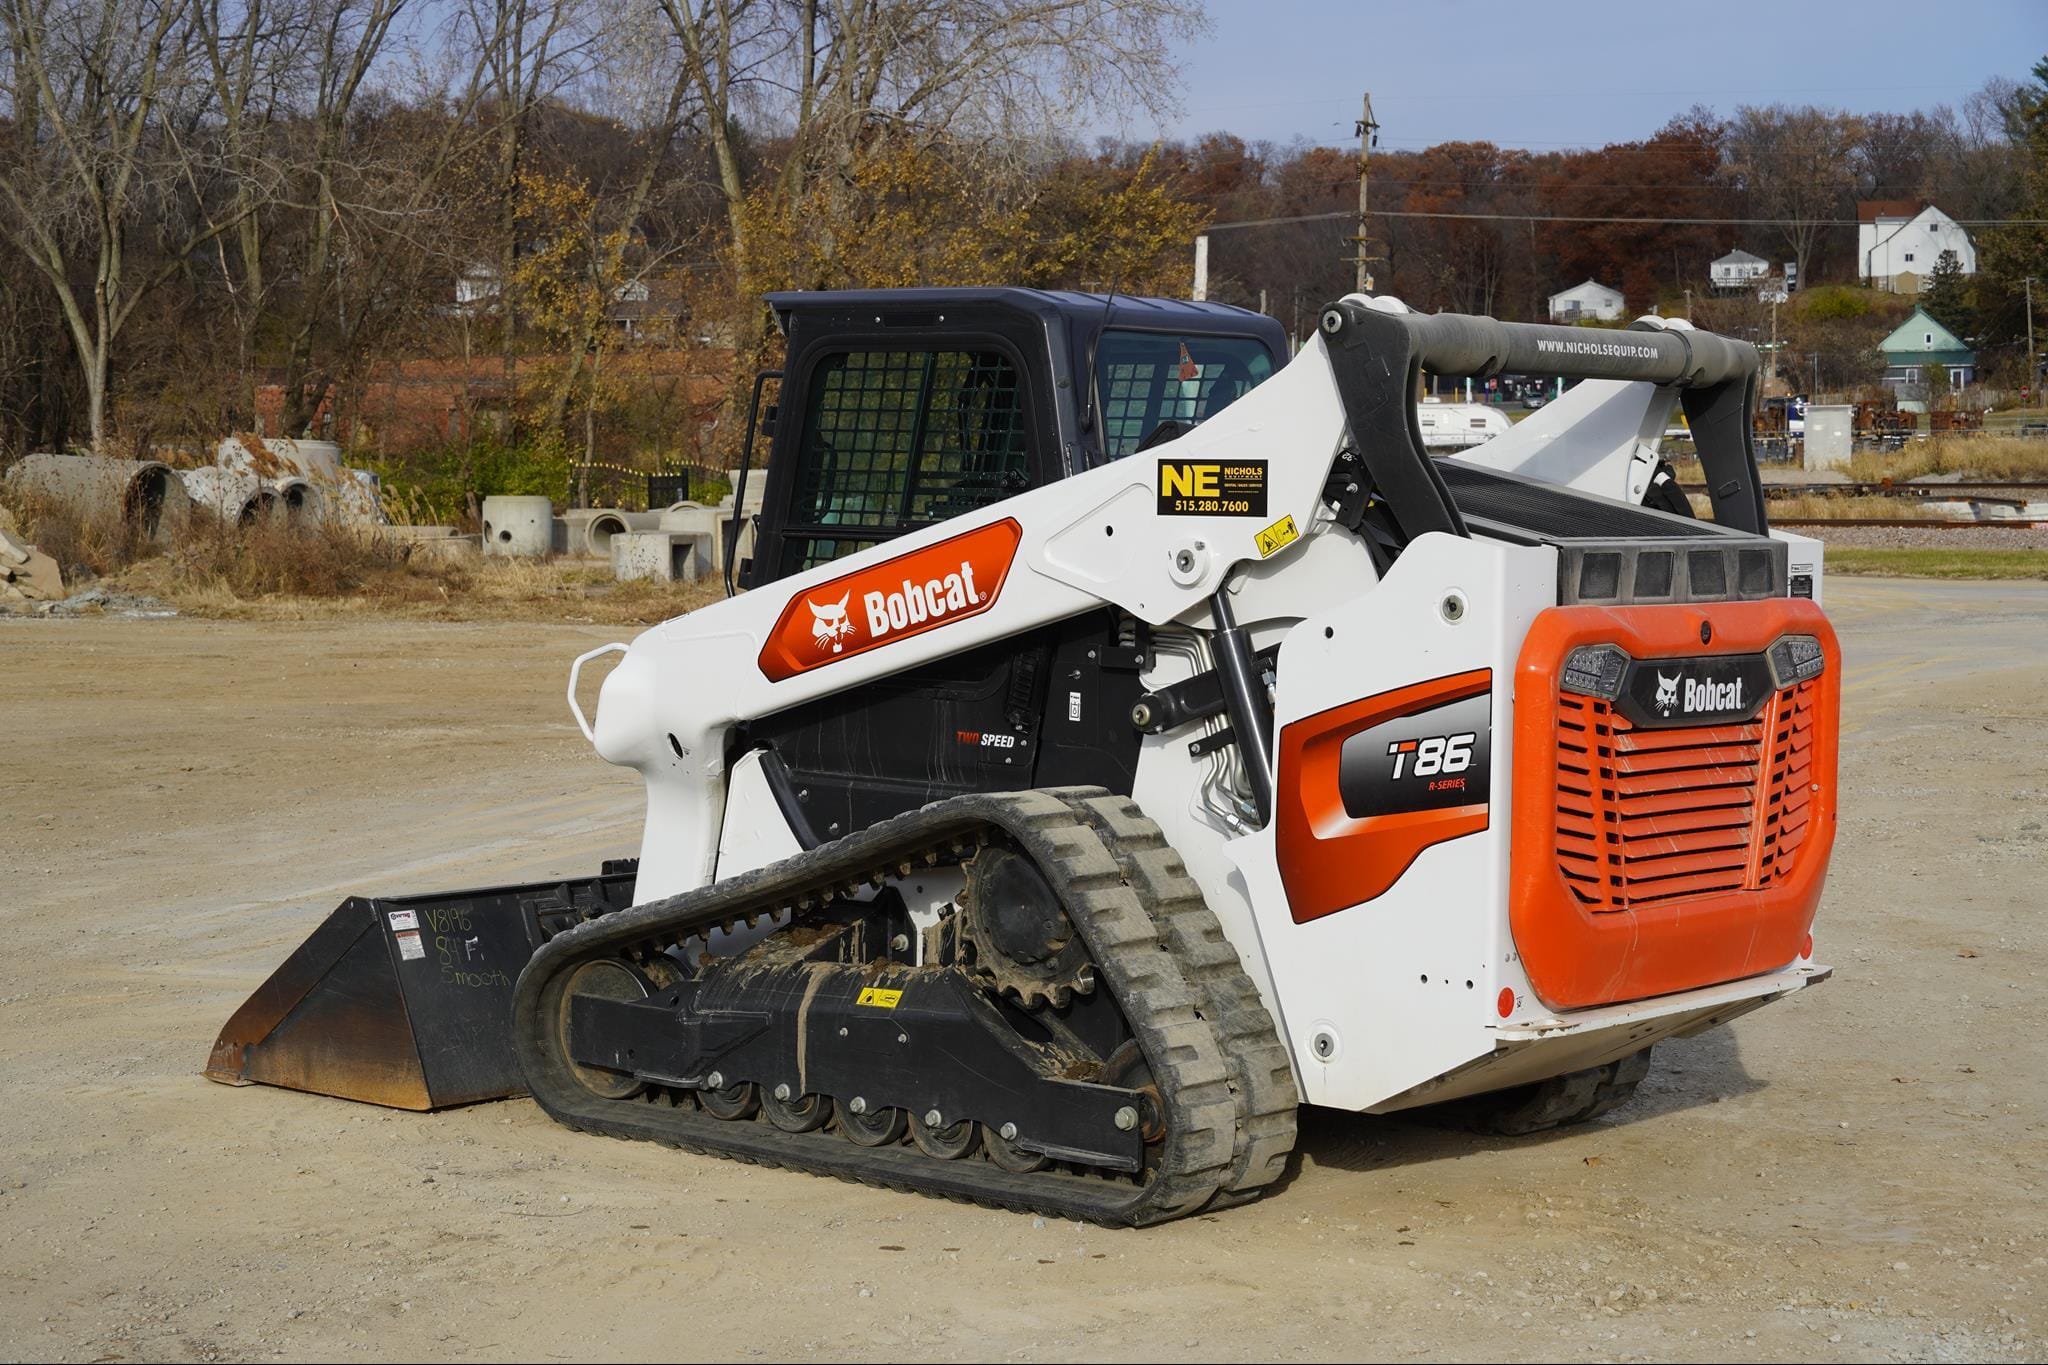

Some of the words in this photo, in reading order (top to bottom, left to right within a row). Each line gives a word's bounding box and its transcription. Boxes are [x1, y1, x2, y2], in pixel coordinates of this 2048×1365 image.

[1537, 339, 1658, 359] WWW.NICHOLSEQUIP.COM
[1162, 465, 1220, 496] NE
[1224, 467, 1263, 475] NICHOLS
[1175, 500, 1249, 512] 515.280.7600
[863, 561, 980, 638] Bobcat
[1683, 677, 1742, 713] Bobcat
[957, 731, 980, 744] TWO
[980, 733, 1015, 748] SPEED
[1387, 732, 1477, 780] T86
[1428, 777, 1466, 791] R-SERIES
